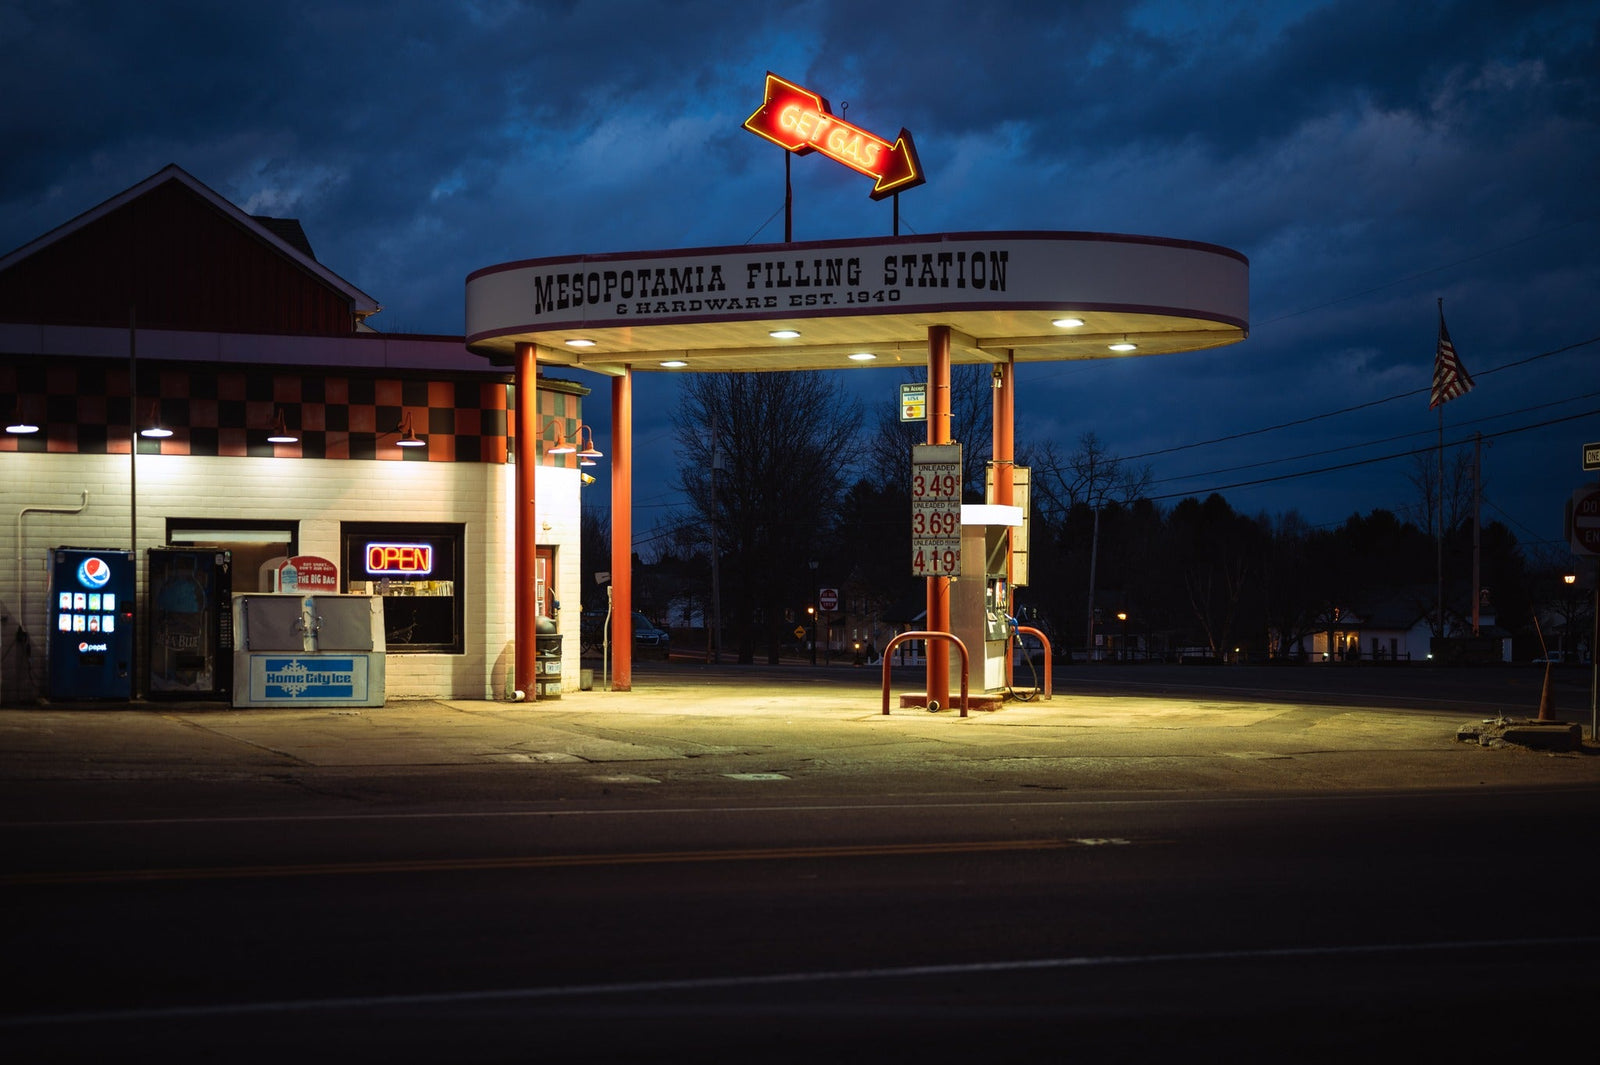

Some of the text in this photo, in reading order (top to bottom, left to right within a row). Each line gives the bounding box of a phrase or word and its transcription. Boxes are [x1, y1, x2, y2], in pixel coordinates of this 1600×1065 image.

[780, 105, 881, 168] GET GAS
[535, 250, 1008, 315] MESOPOTAMIA FILLING STATION
[616, 290, 900, 315] & HARDWARE EST. 1940
[1588, 451, 1600, 462] ONE
[914, 475, 955, 497] 3.49
[914, 513, 955, 534] 3.69
[370, 547, 429, 571] OPEN
[914, 551, 955, 572] 4.19
[298, 573, 335, 584] THE BIG BAG
[266, 673, 352, 685] Home City Ice
